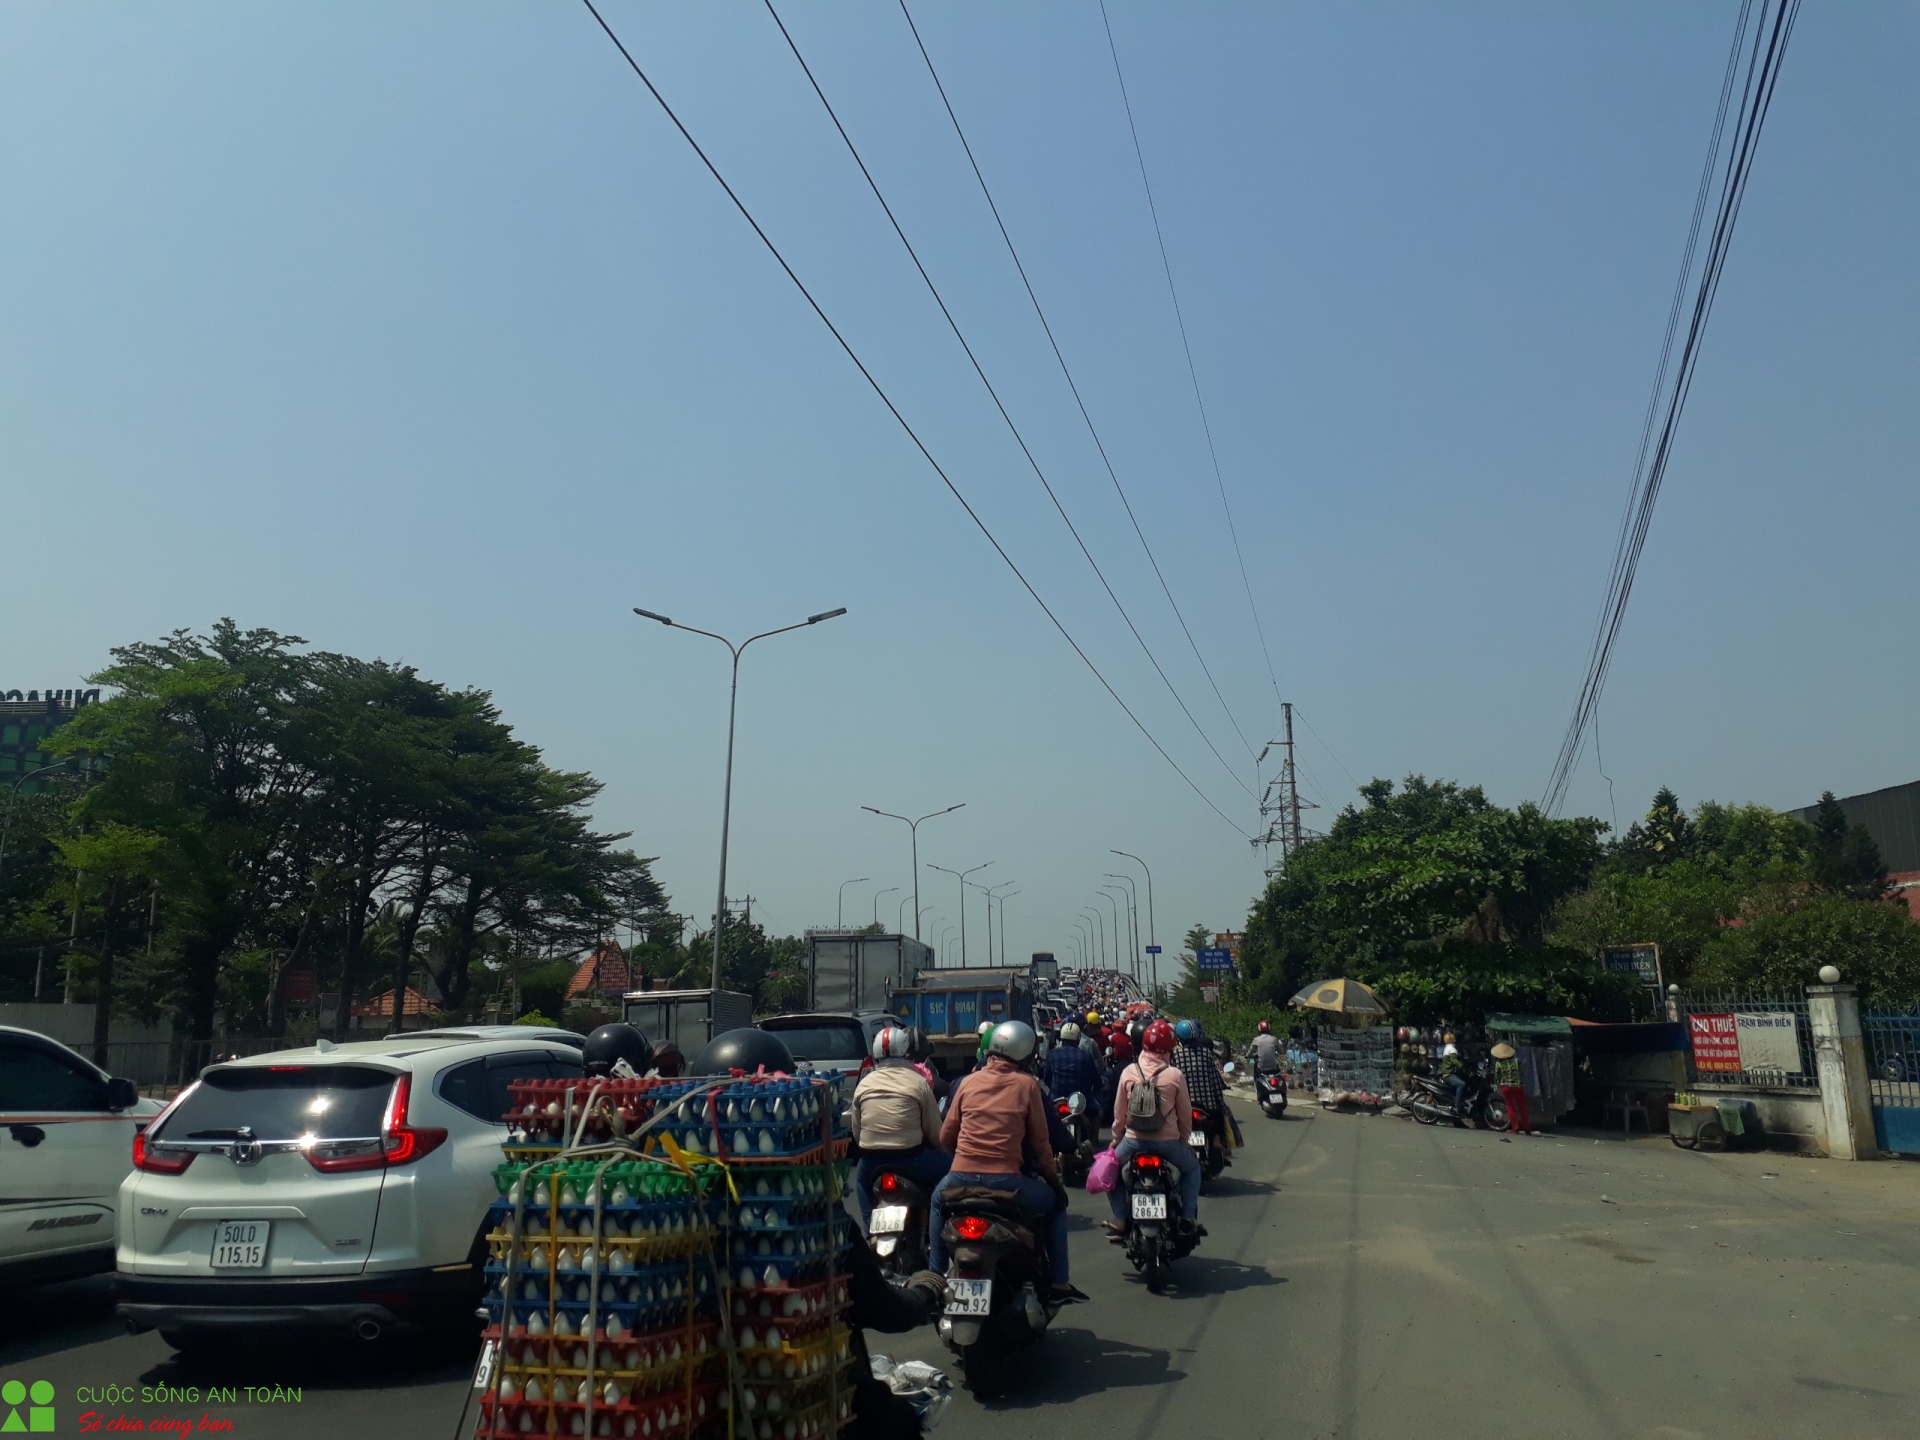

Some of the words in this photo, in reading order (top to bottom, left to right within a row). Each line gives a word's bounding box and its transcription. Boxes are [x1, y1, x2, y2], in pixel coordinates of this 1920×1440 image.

[929, 1001, 944, 1014] 51C
[1691, 1018, 1709, 1033] CHO
[1711, 1015, 1735, 1033] THUÊ
[1135, 1207, 1164, 1217] 286.21
[875, 1219, 900, 1231] 0326
[224, 1225, 256, 1243] 50LD
[219, 1246, 260, 1263] 115.15
[953, 1282, 983, 1296] 71-C1
